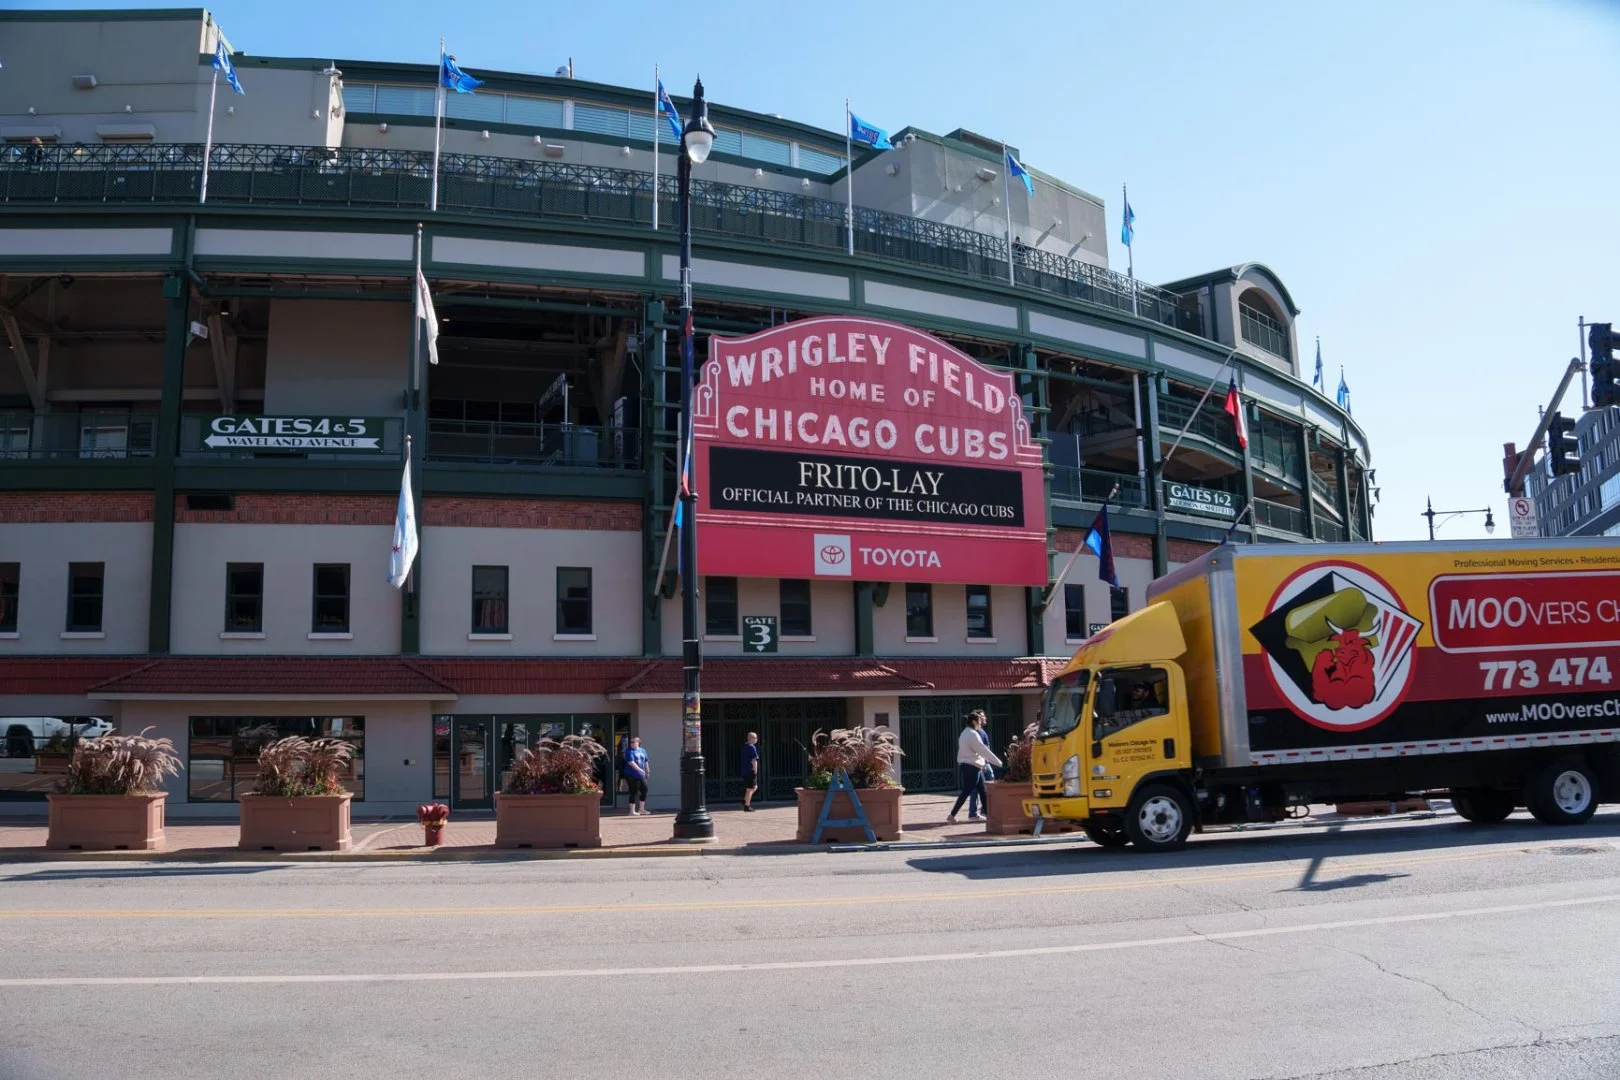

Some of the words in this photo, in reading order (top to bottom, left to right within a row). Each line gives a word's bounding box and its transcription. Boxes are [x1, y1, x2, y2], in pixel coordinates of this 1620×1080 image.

[725, 332, 891, 388] WRIGLEY
[908, 343, 1005, 415] FIELD
[810, 377, 886, 404] HOME
[904, 387, 936, 409] OF
[211, 417, 312, 435] GATES
[726, 405, 897, 450] CHICAGO
[914, 423, 1009, 461] CUBS
[306, 437, 358, 448] AVENUE
[798, 461, 945, 496] FRITO-LAY
[722, 487, 794, 505] OFFICIAL
[796, 492, 861, 510] PARTNER
[864, 497, 884, 511] OF
[886, 498, 915, 513] THE
[916, 500, 979, 518] CHICAGO
[981, 504, 1015, 519] CUBS
[1171, 485, 1211, 503] GATES
[858, 547, 942, 568] TOYOTA
[1454, 558, 1507, 568] Professional
[1508, 558, 1538, 567] Moving
[1539, 557, 1574, 566] Services
[745, 617, 775, 625] GATE
[1448, 596, 1591, 630] MOOVERS
[749, 624, 771, 645] 3
[1090, 624, 1107, 632] GAT
[1479, 659, 1540, 690] 773
[1548, 656, 1612, 686] 474
